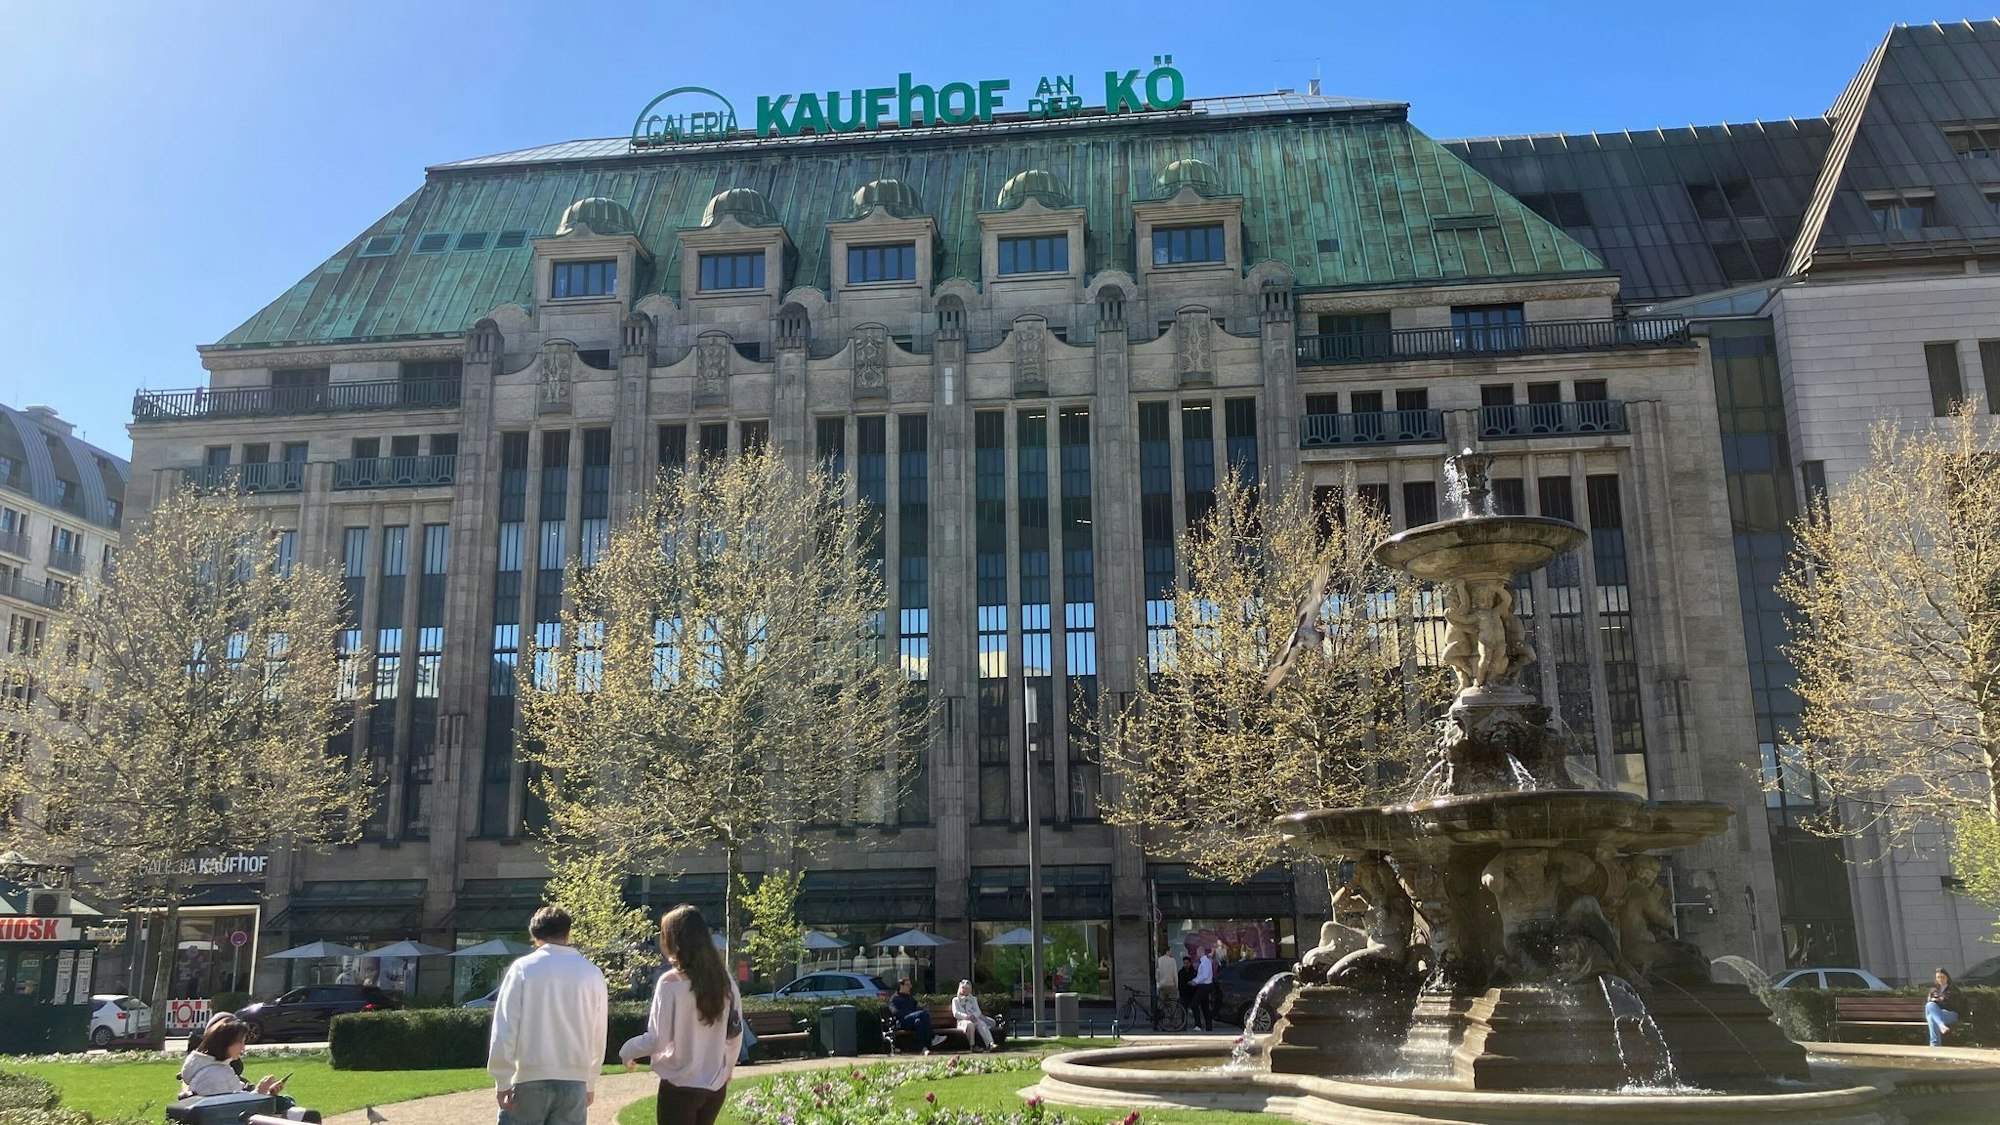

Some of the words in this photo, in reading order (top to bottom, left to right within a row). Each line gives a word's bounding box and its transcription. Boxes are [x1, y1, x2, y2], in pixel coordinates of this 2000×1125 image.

[1035, 74, 1074, 98] AN
[1105, 55, 1185, 114] KÖ
[1028, 95, 1083, 118] DER
[646, 110, 740, 145] GALERIA
